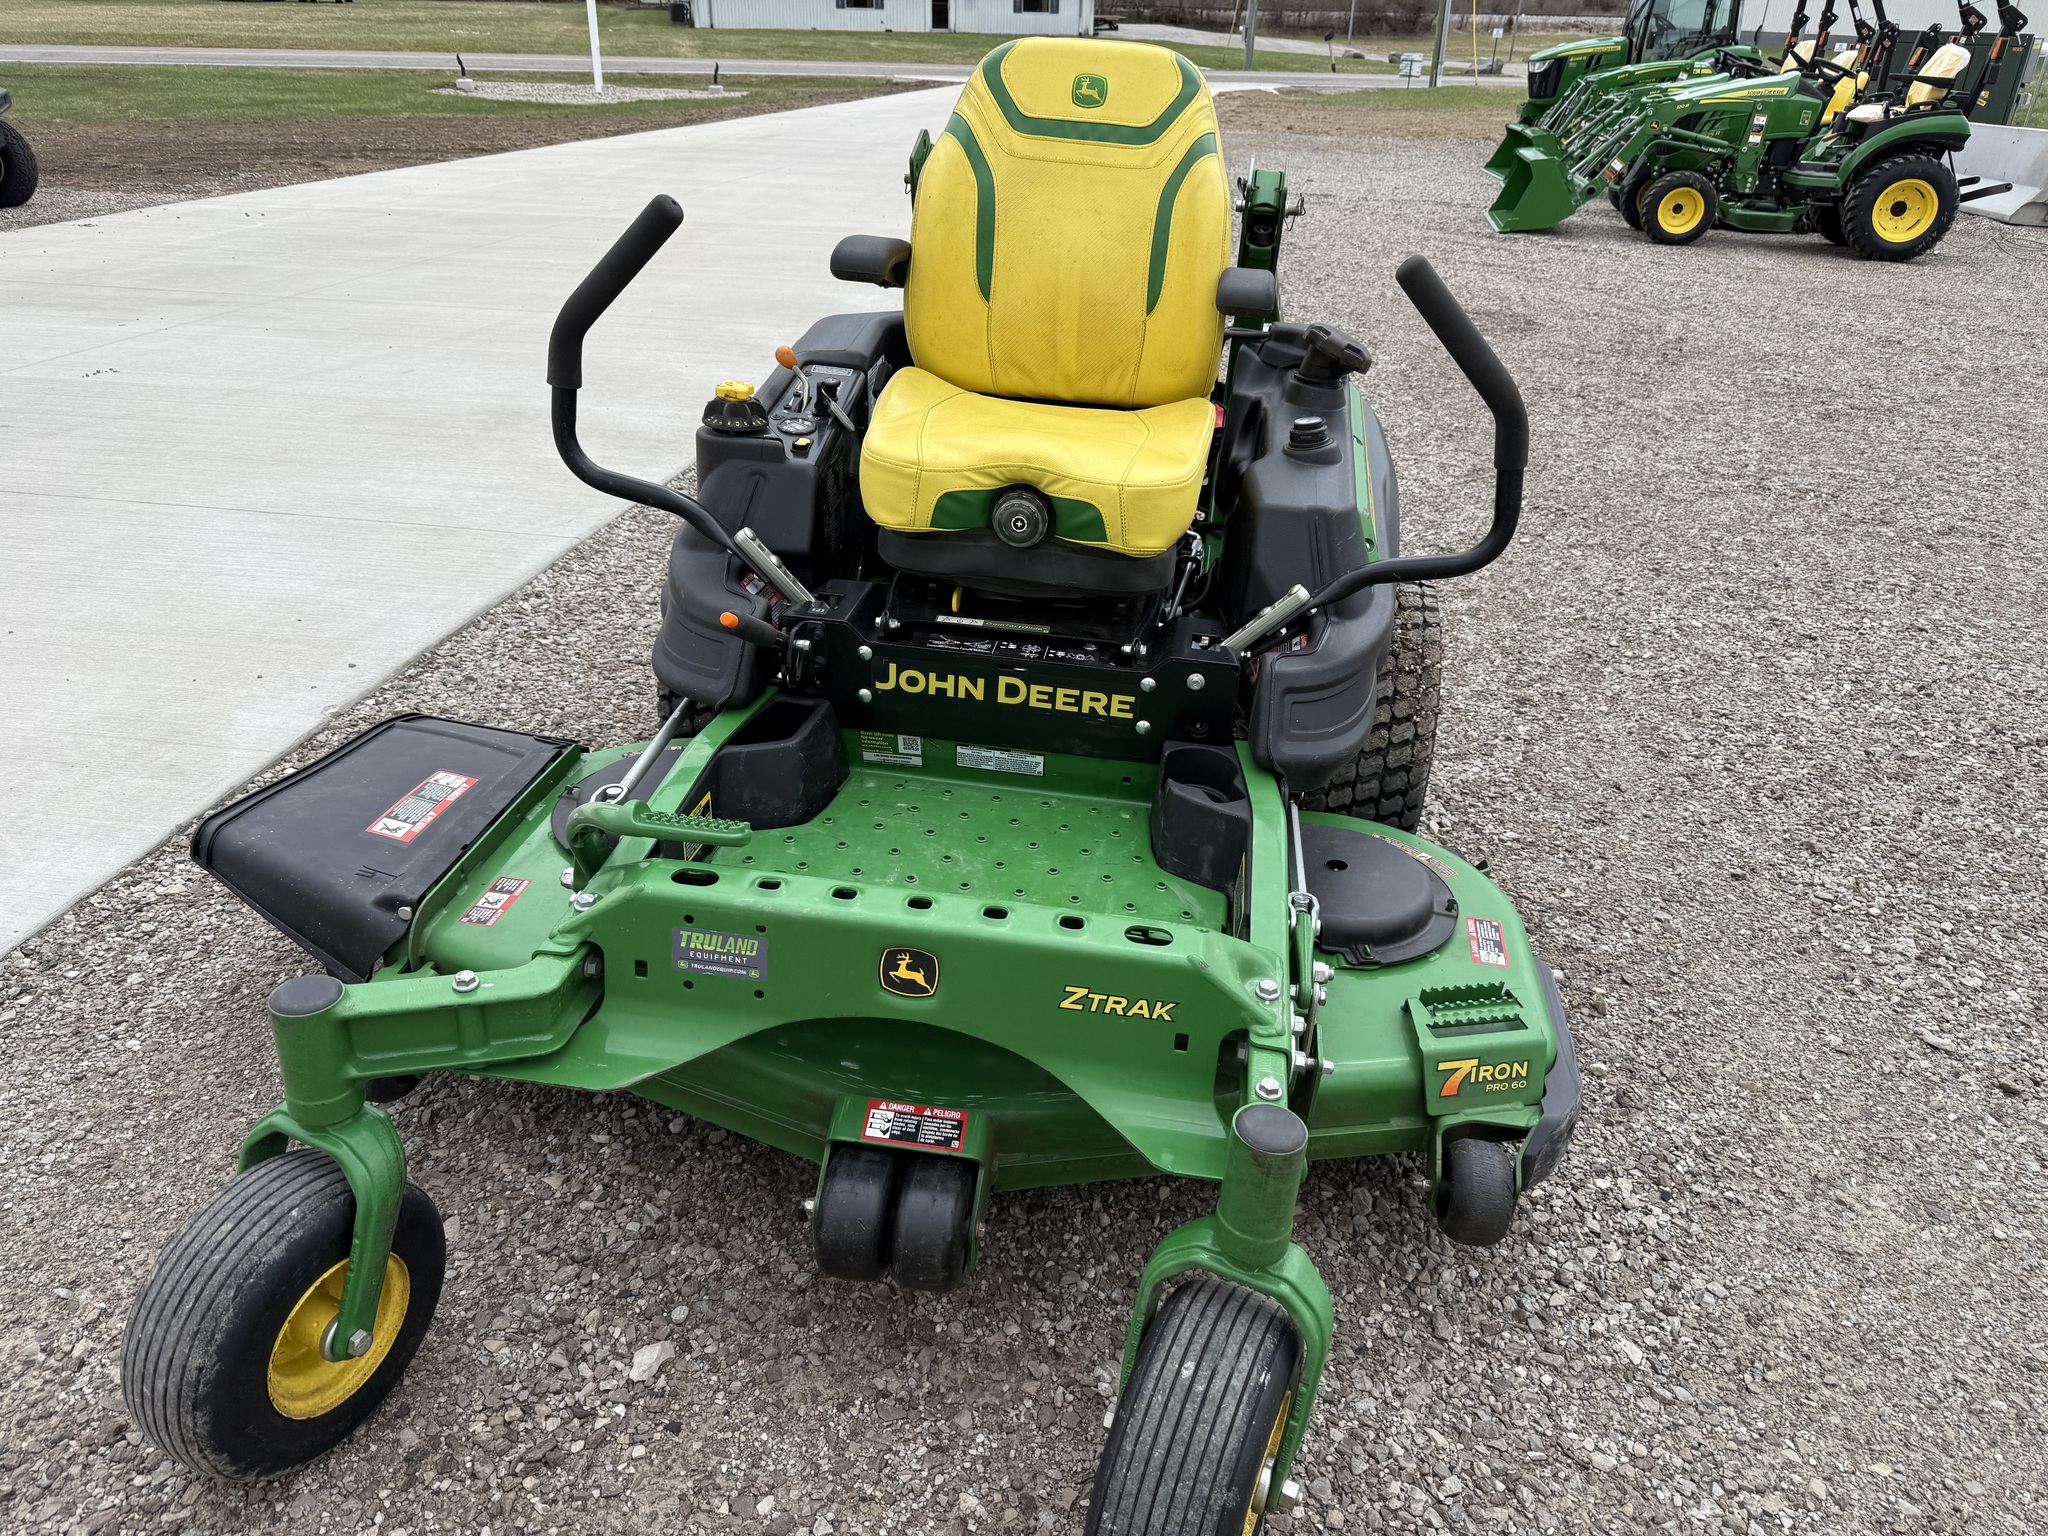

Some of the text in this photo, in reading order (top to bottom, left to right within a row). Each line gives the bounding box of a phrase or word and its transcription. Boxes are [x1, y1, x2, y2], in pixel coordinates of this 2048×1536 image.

[875, 663, 1136, 719] JOHN DEERE
[680, 930, 758, 956] TRULAND
[690, 950, 748, 964] EQUIPMENT
[691, 963, 747, 975] TRULANDEQUIP.COM
[1058, 985, 1179, 1022] ZTRAK
[1485, 1080, 1527, 1092] PRO 60
[888, 1102, 915, 1113] DANGER
[933, 1109, 961, 1118] PELIGRO
